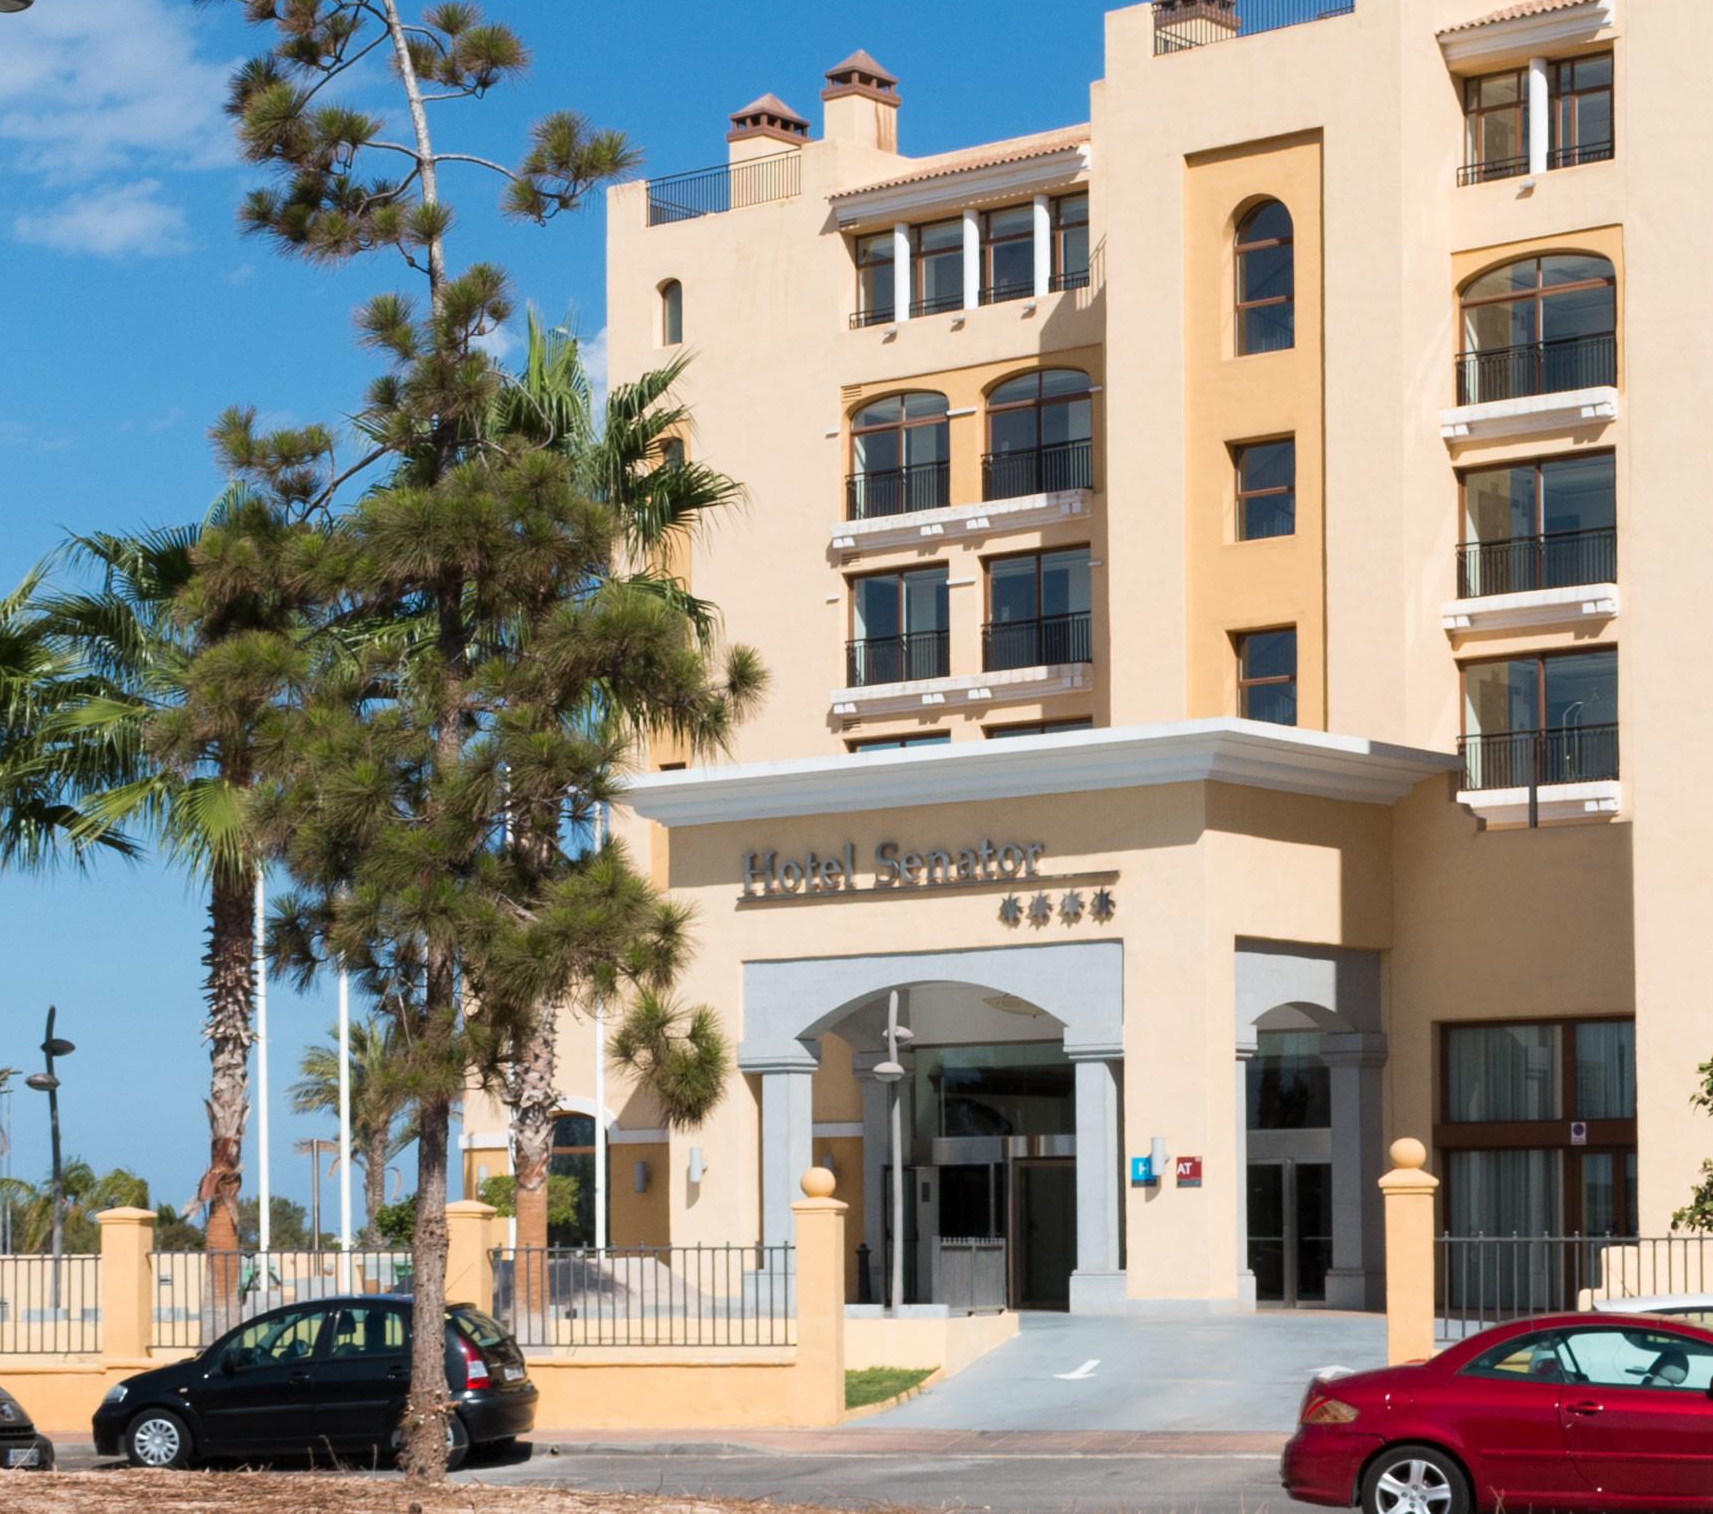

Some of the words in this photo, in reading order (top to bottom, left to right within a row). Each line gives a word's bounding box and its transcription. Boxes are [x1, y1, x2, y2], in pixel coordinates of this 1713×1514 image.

[742, 842, 856, 895] Hotel
[873, 837, 1045, 886] Senator
[1177, 1161, 1193, 1175] AT
